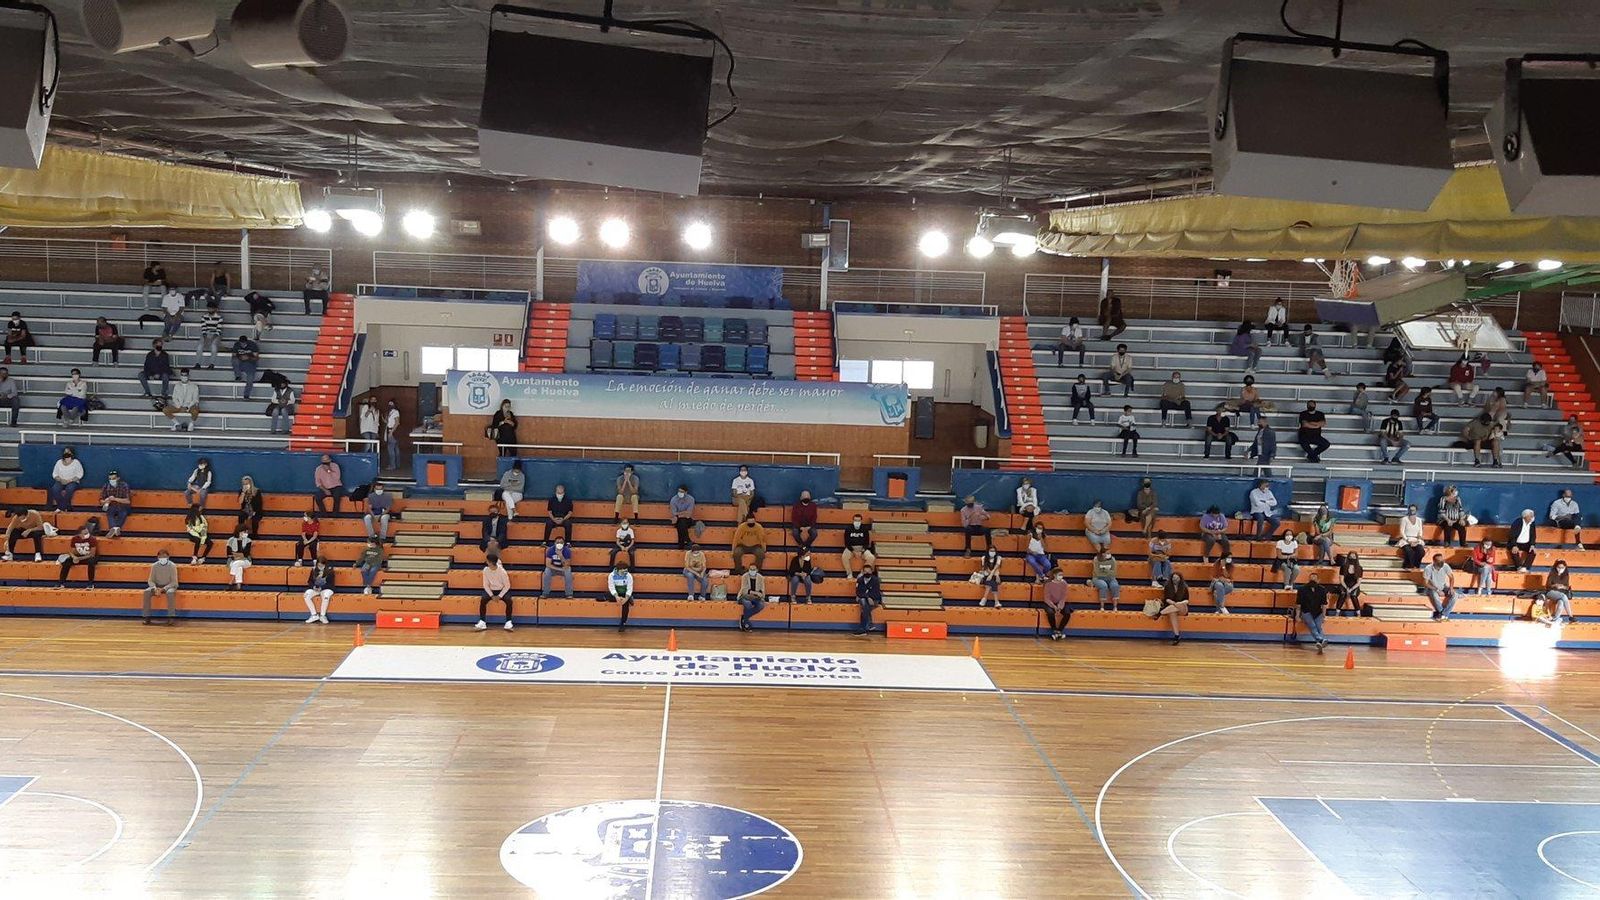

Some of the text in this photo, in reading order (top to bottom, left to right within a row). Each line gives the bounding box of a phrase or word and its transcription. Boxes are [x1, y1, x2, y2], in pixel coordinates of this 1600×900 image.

[501, 376, 580, 387] Ayuntamiento
[523, 386, 579, 397] de Huelva
[604, 380, 844, 399] La emoción de ganar debe ser mayor
[659, 398, 674, 409] al
[719, 399, 734, 411] de
[601, 653, 857, 664] Ayuntamiento
[676, 663, 860, 673] de Huelva
